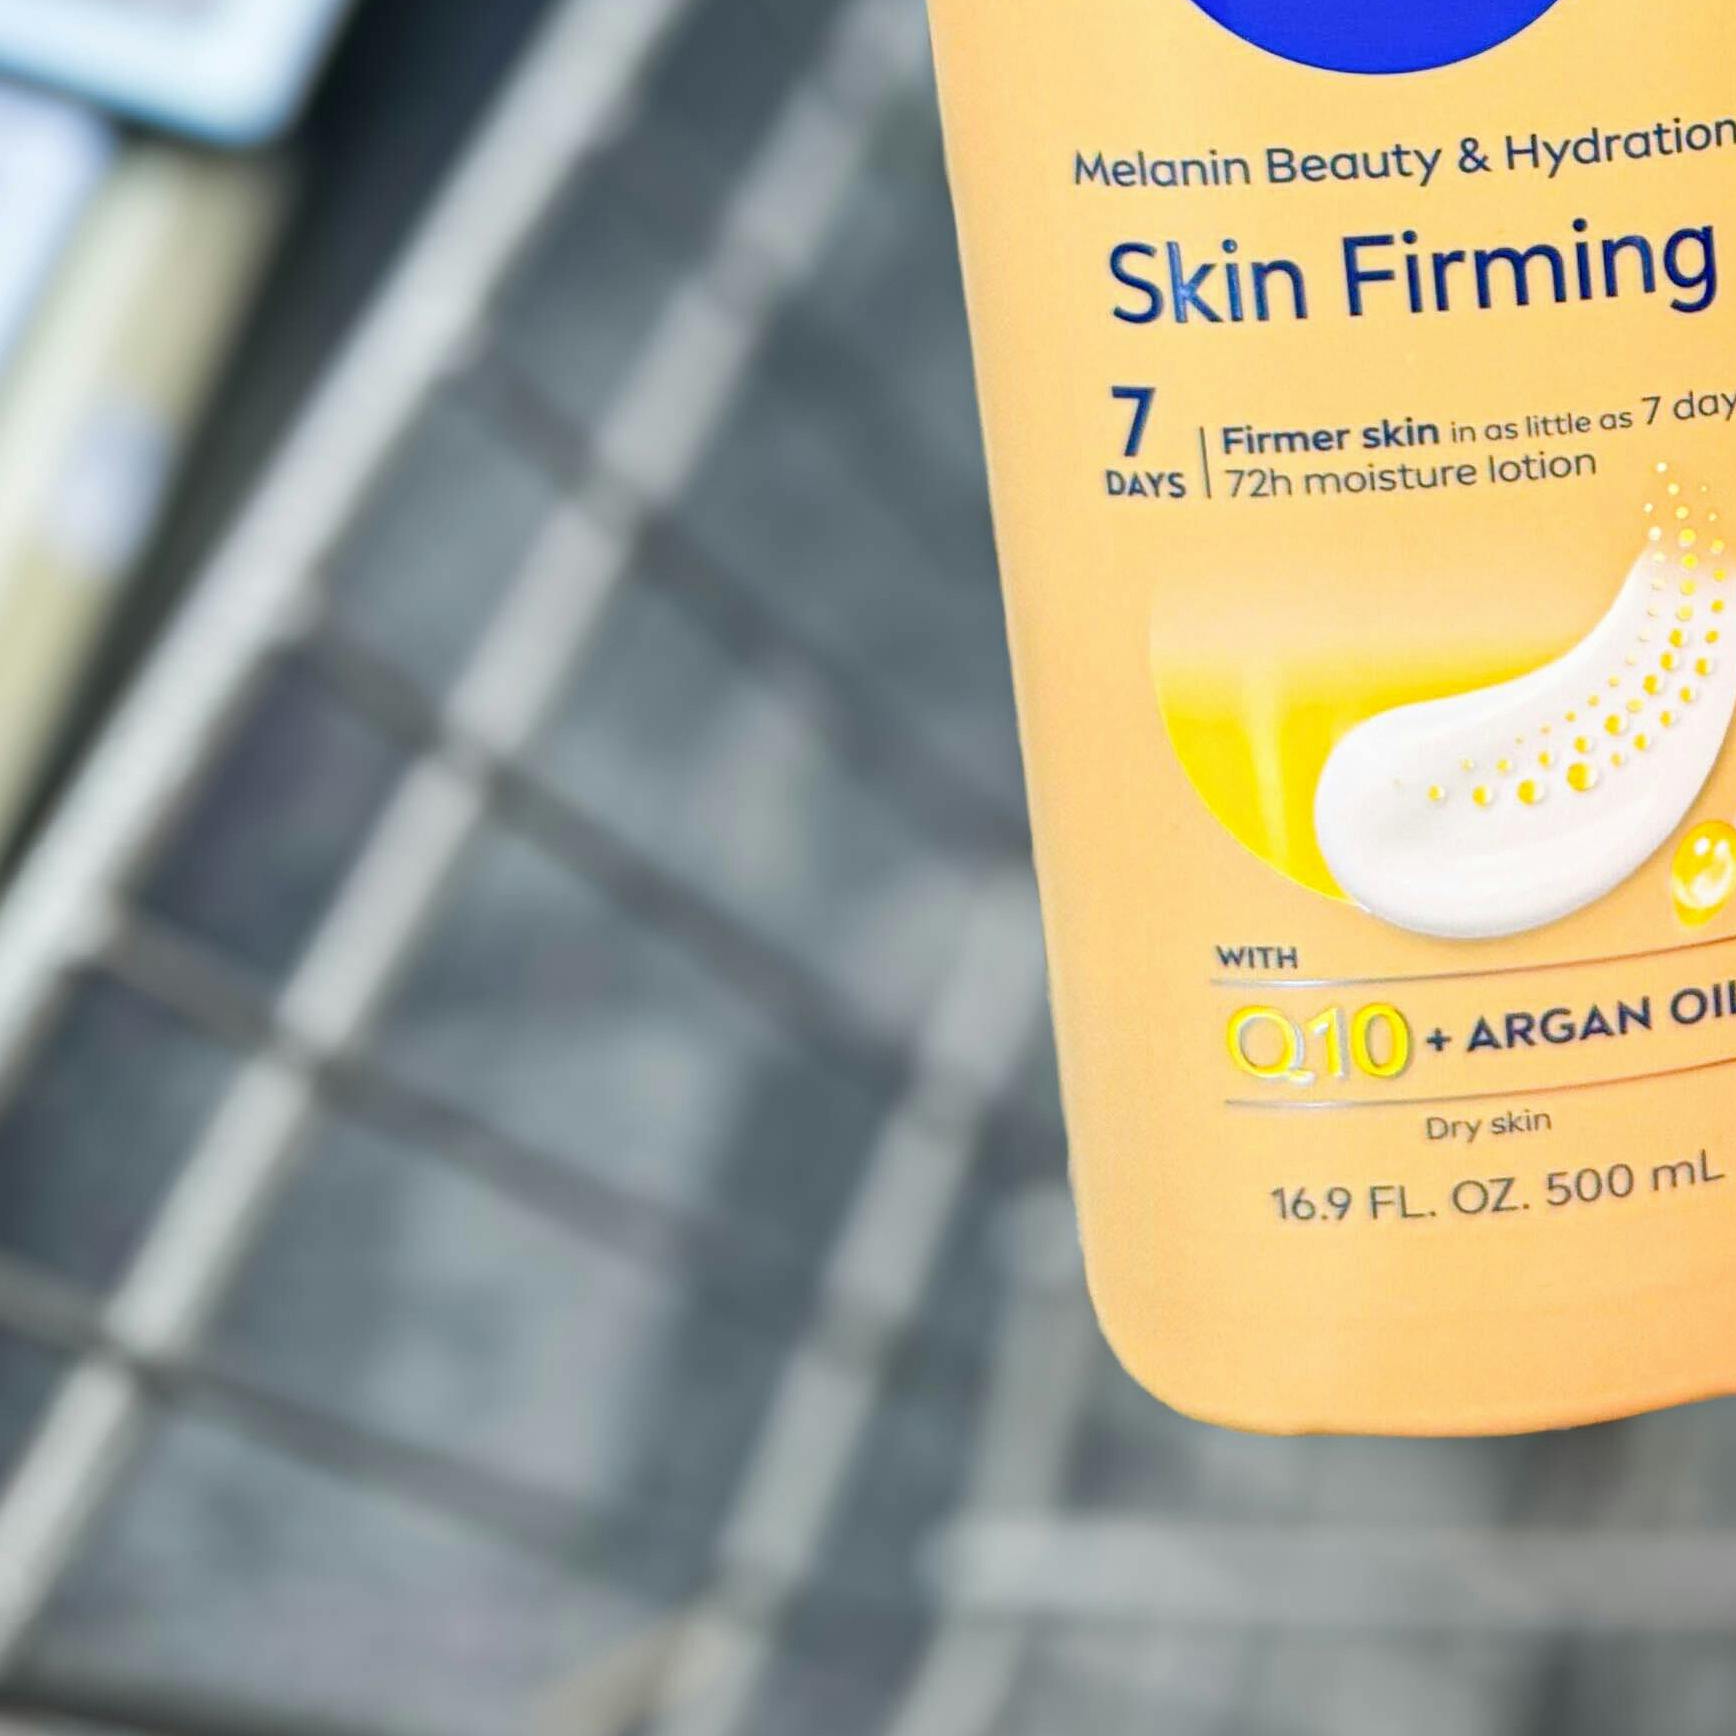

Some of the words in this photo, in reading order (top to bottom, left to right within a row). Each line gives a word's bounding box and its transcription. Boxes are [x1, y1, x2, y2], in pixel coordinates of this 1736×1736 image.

[1074, 149, 1252, 189] Melanin
[1267, 141, 1442, 188] Beauty
[1458, 137, 1492, 173] &
[1109, 238, 1308, 325] Skin
[1342, 217, 1718, 315] Firming
[1111, 385, 1156, 457] 7
[1221, 424, 1351, 456] Firmer
[1361, 416, 1440, 451] skin
[1450, 419, 1476, 444] in
[1483, 421, 1519, 443] as
[1525, 409, 1592, 440] little
[1598, 406, 1634, 432] as
[1640, 394, 1661, 426] 7
[1104, 468, 1187, 499] DAYS
[1224, 465, 1291, 499] 72h
[1304, 456, 1478, 496] moisture
[1488, 448, 1598, 484] lotion
[1216, 944, 1299, 970] WITH
[1225, 1002, 1414, 1086] Q10
[1465, 996, 1653, 1054] ARGAN
[1424, 1113, 1482, 1145] Dry
[1491, 1107, 1553, 1137] skin
[1269, 1184, 1353, 1223] 16.9
[1370, 1183, 1437, 1221] FL.
[1450, 1176, 1531, 1217] OZ.
[1545, 1161, 1635, 1209] 500
[1651, 1148, 1726, 1195] mL
